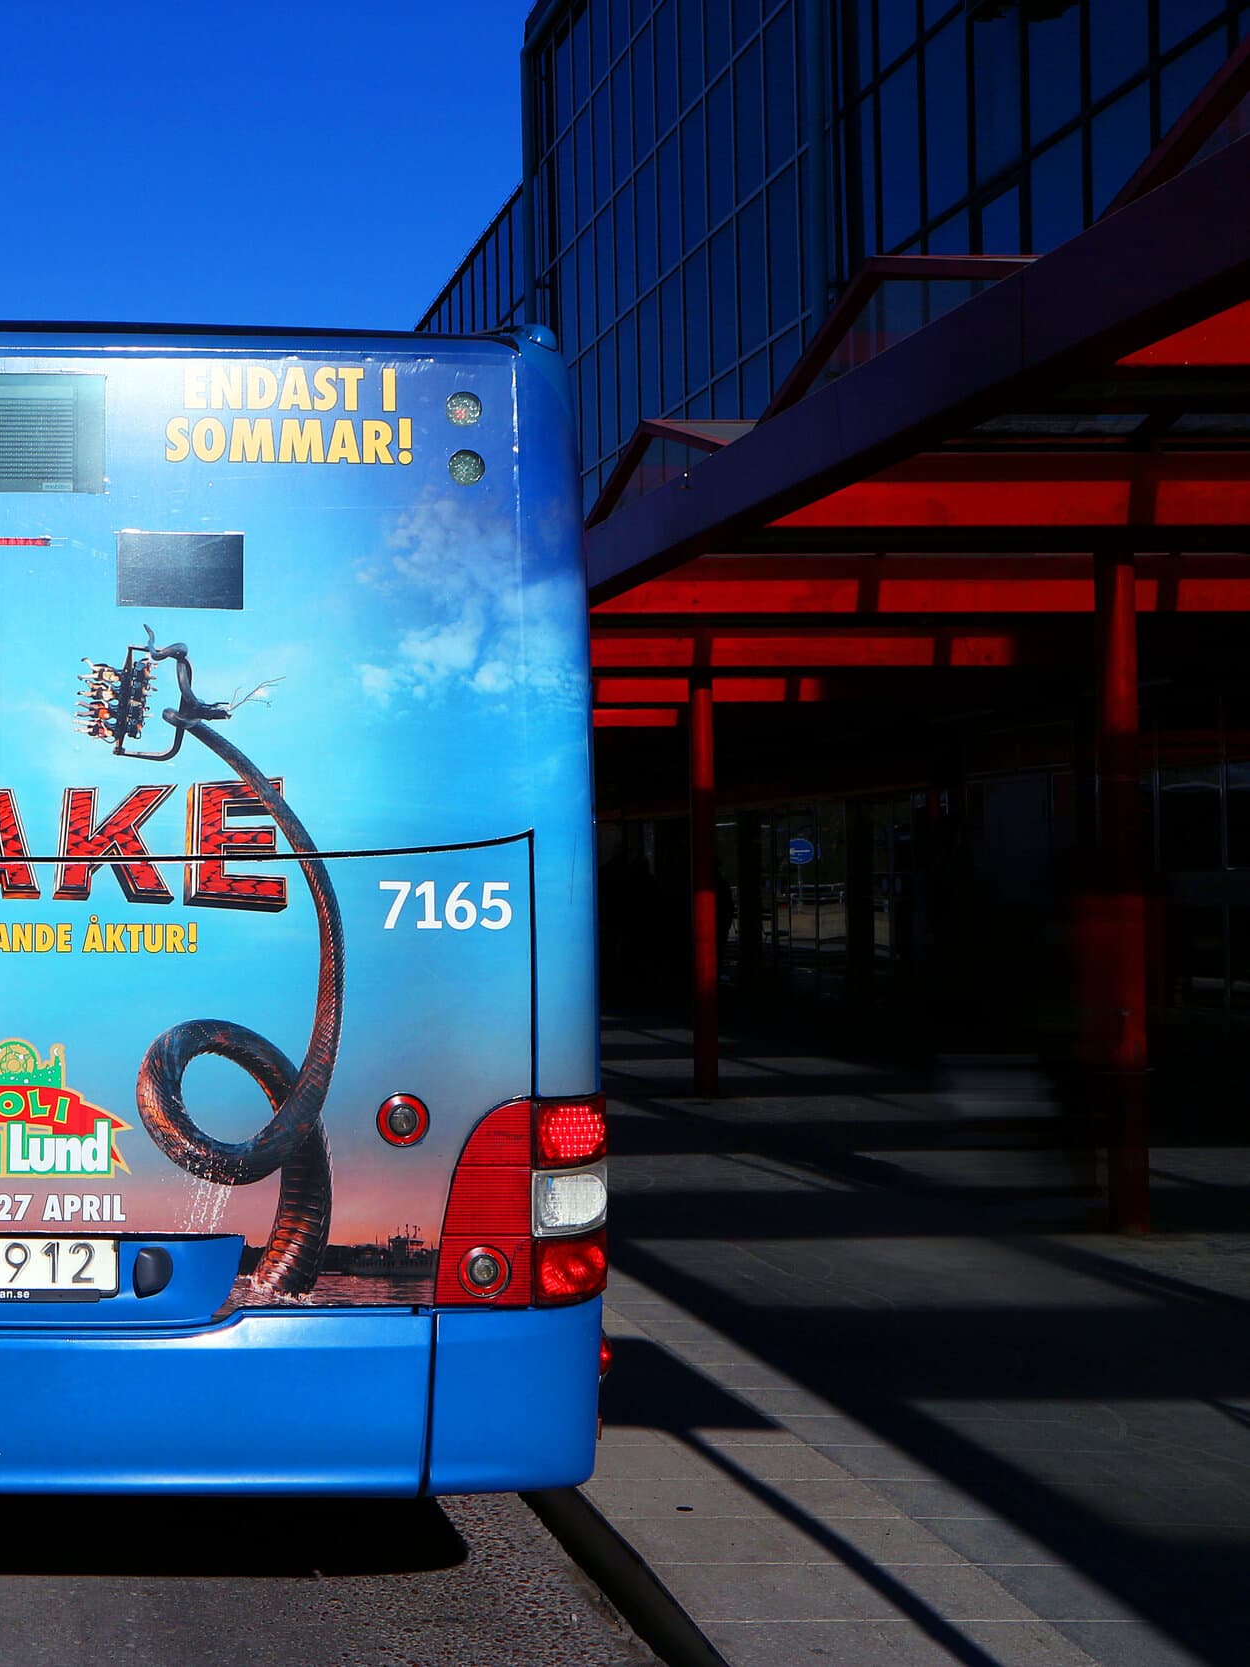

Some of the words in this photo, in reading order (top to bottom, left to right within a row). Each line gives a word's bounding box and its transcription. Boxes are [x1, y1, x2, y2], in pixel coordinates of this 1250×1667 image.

[183, 366, 365, 412] ENDAST
[381, 367, 397, 412] I
[165, 417, 414, 465] SOMMAR!
[379, 880, 512, 930] 7165
[82, 914, 198, 953] ÅKTUR!
[7, 1120, 111, 1175] Lund
[41, 1194, 127, 1222] APRIL
[4, 1241, 96, 1284] 912
